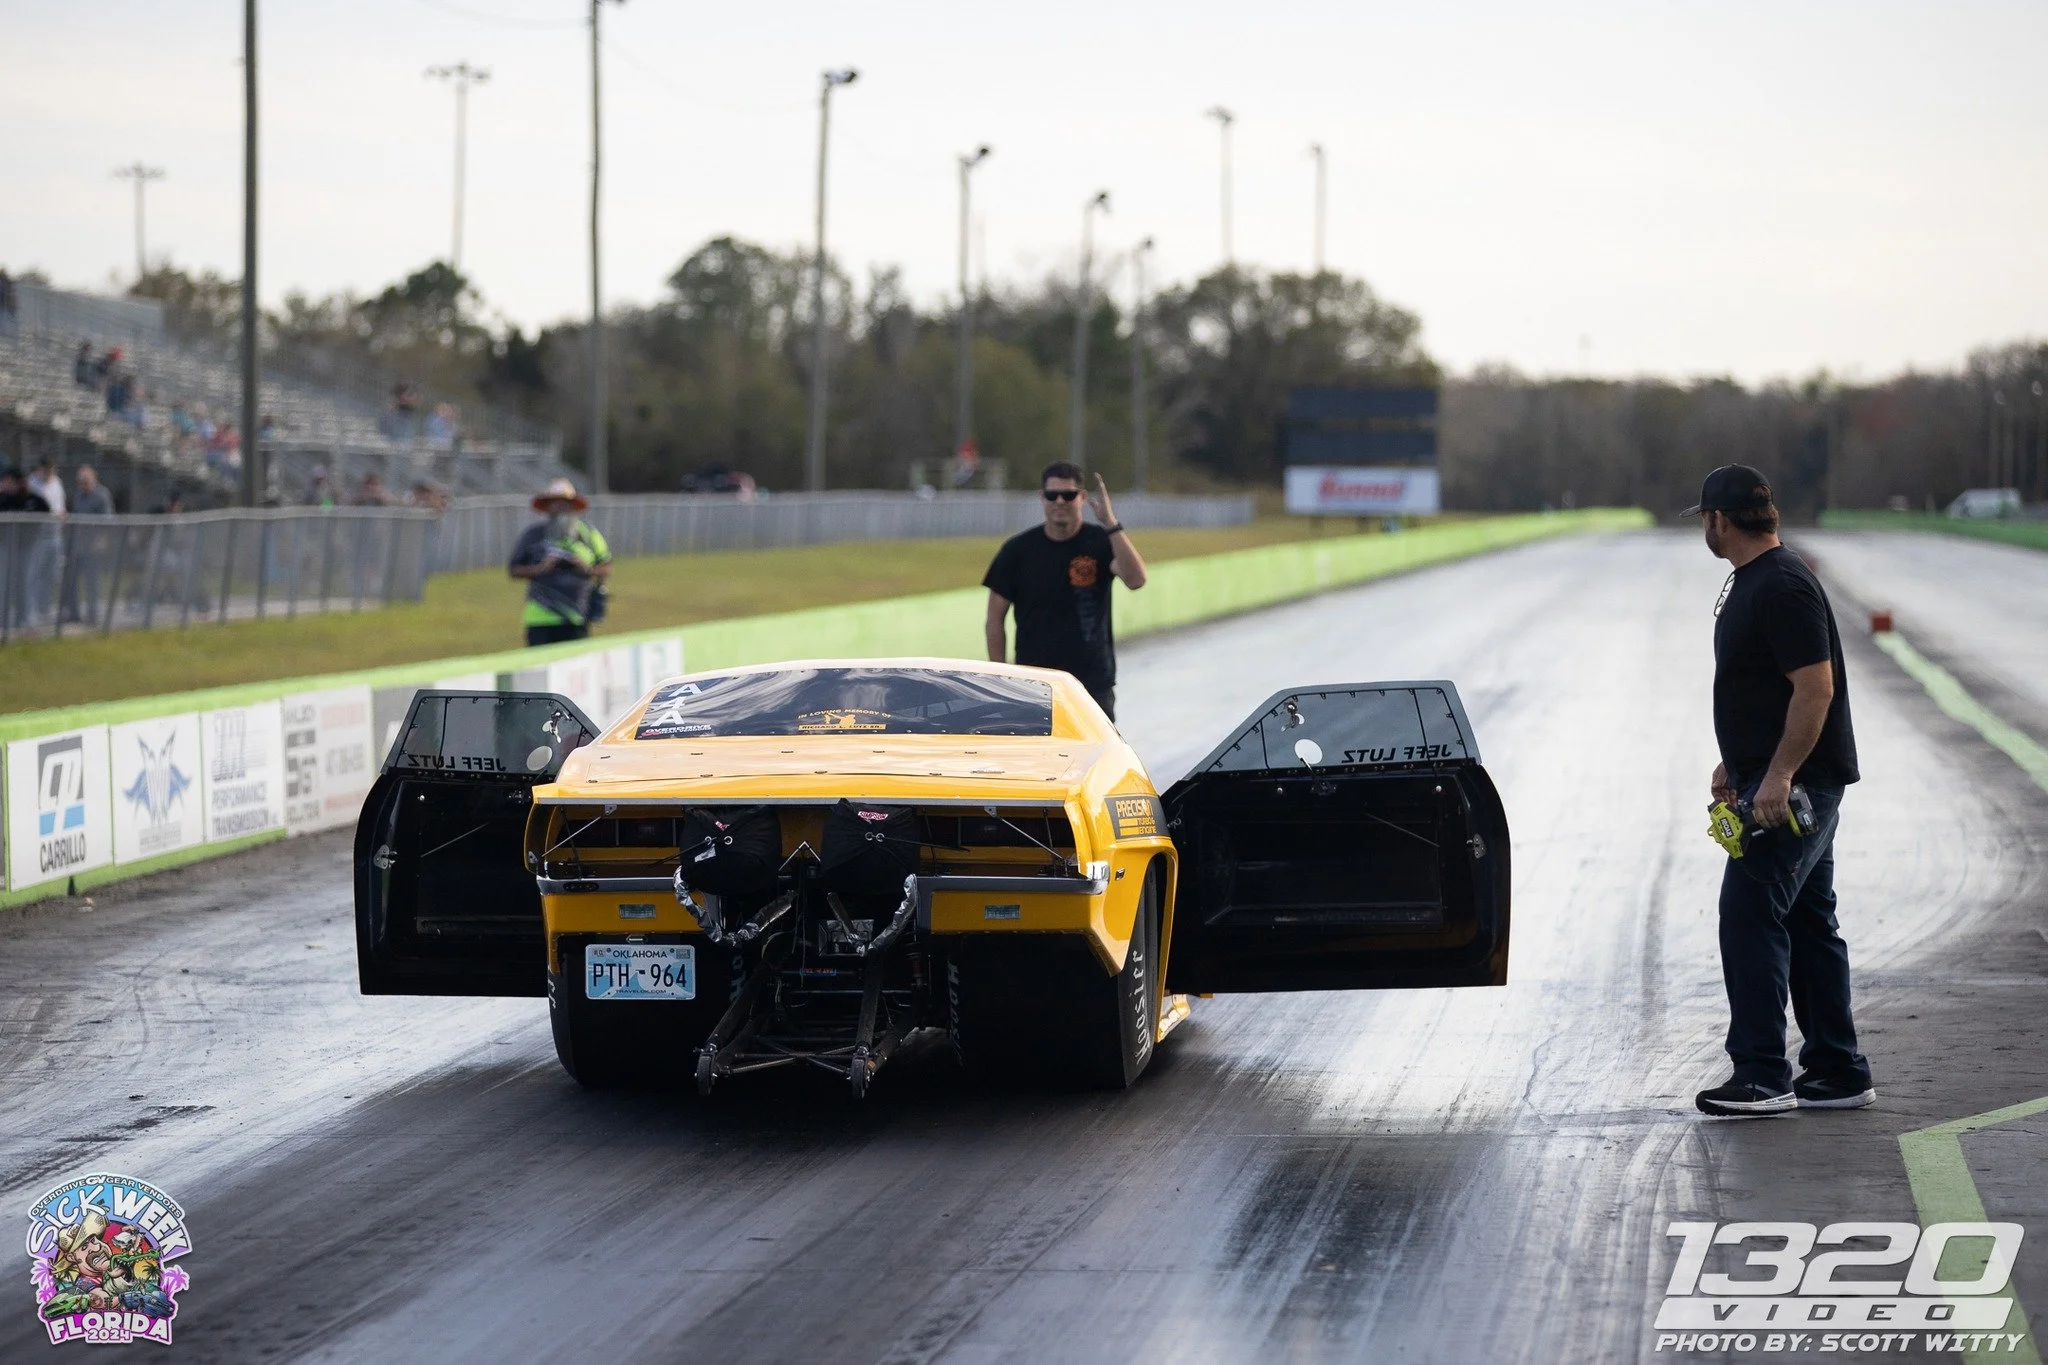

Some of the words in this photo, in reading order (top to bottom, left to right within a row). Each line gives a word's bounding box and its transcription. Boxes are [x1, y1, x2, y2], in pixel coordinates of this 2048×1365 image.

[810, 709, 842, 717] LOVING
[40, 833, 86, 873] CARRILLO
[612, 950, 668, 959] OKLAHOMA
[593, 963, 630, 987] PTH
[650, 963, 687, 987] 964
